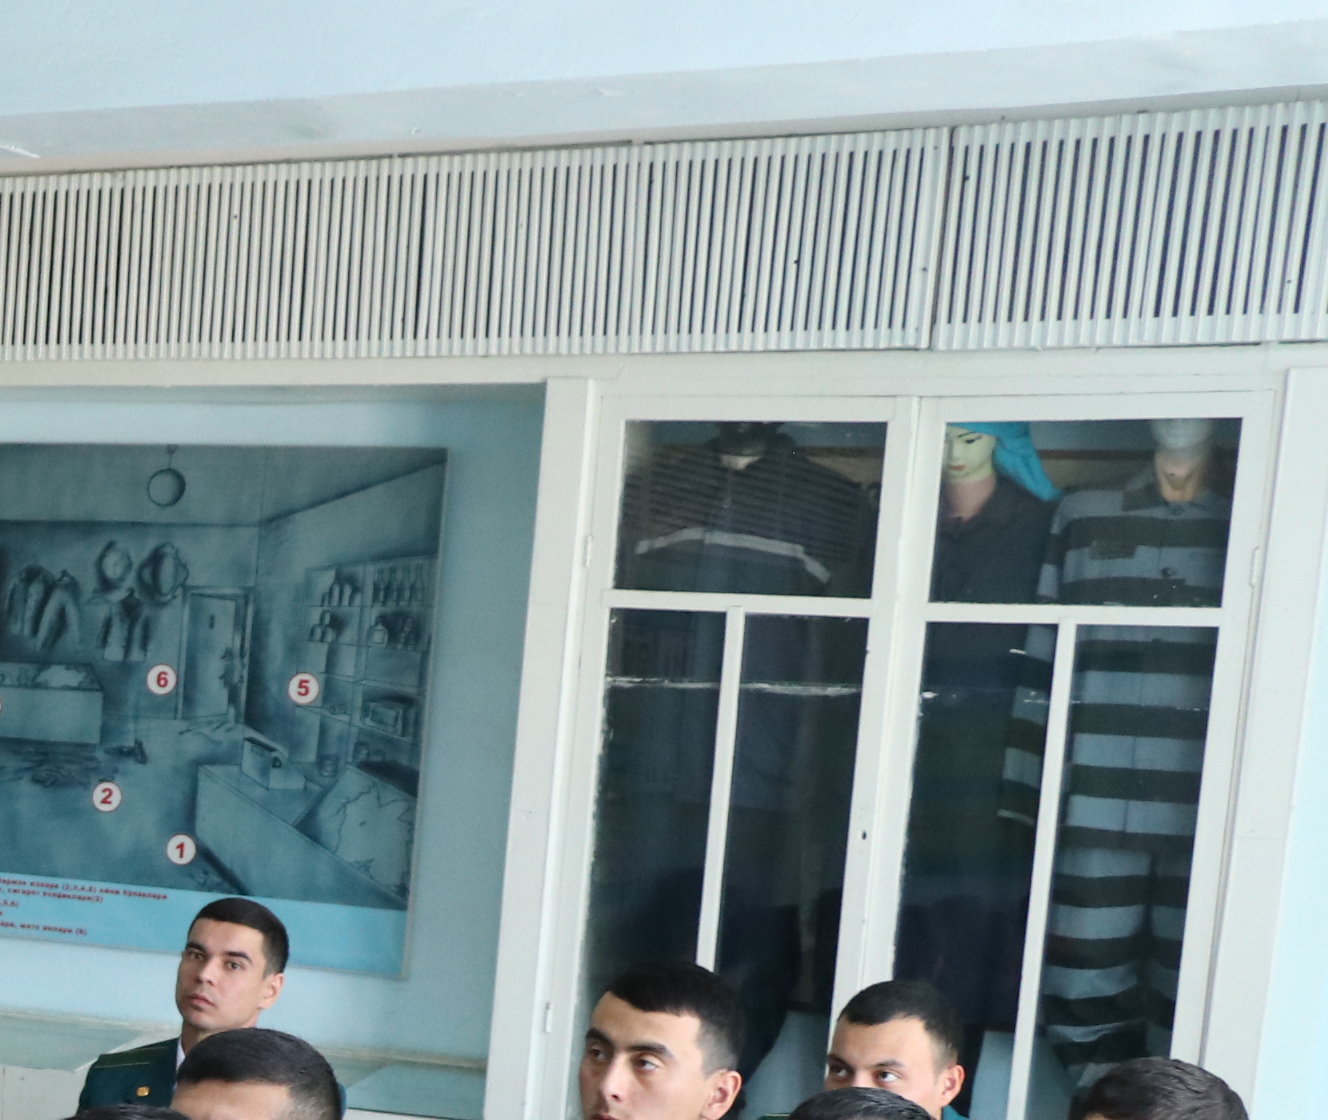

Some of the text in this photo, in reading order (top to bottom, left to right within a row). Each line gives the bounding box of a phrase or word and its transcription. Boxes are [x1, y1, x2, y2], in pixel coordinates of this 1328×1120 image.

[157, 671, 169, 688] 6
[298, 679, 310, 696] 5
[100, 788, 113, 804] 2
[176, 842, 185, 858] 1
